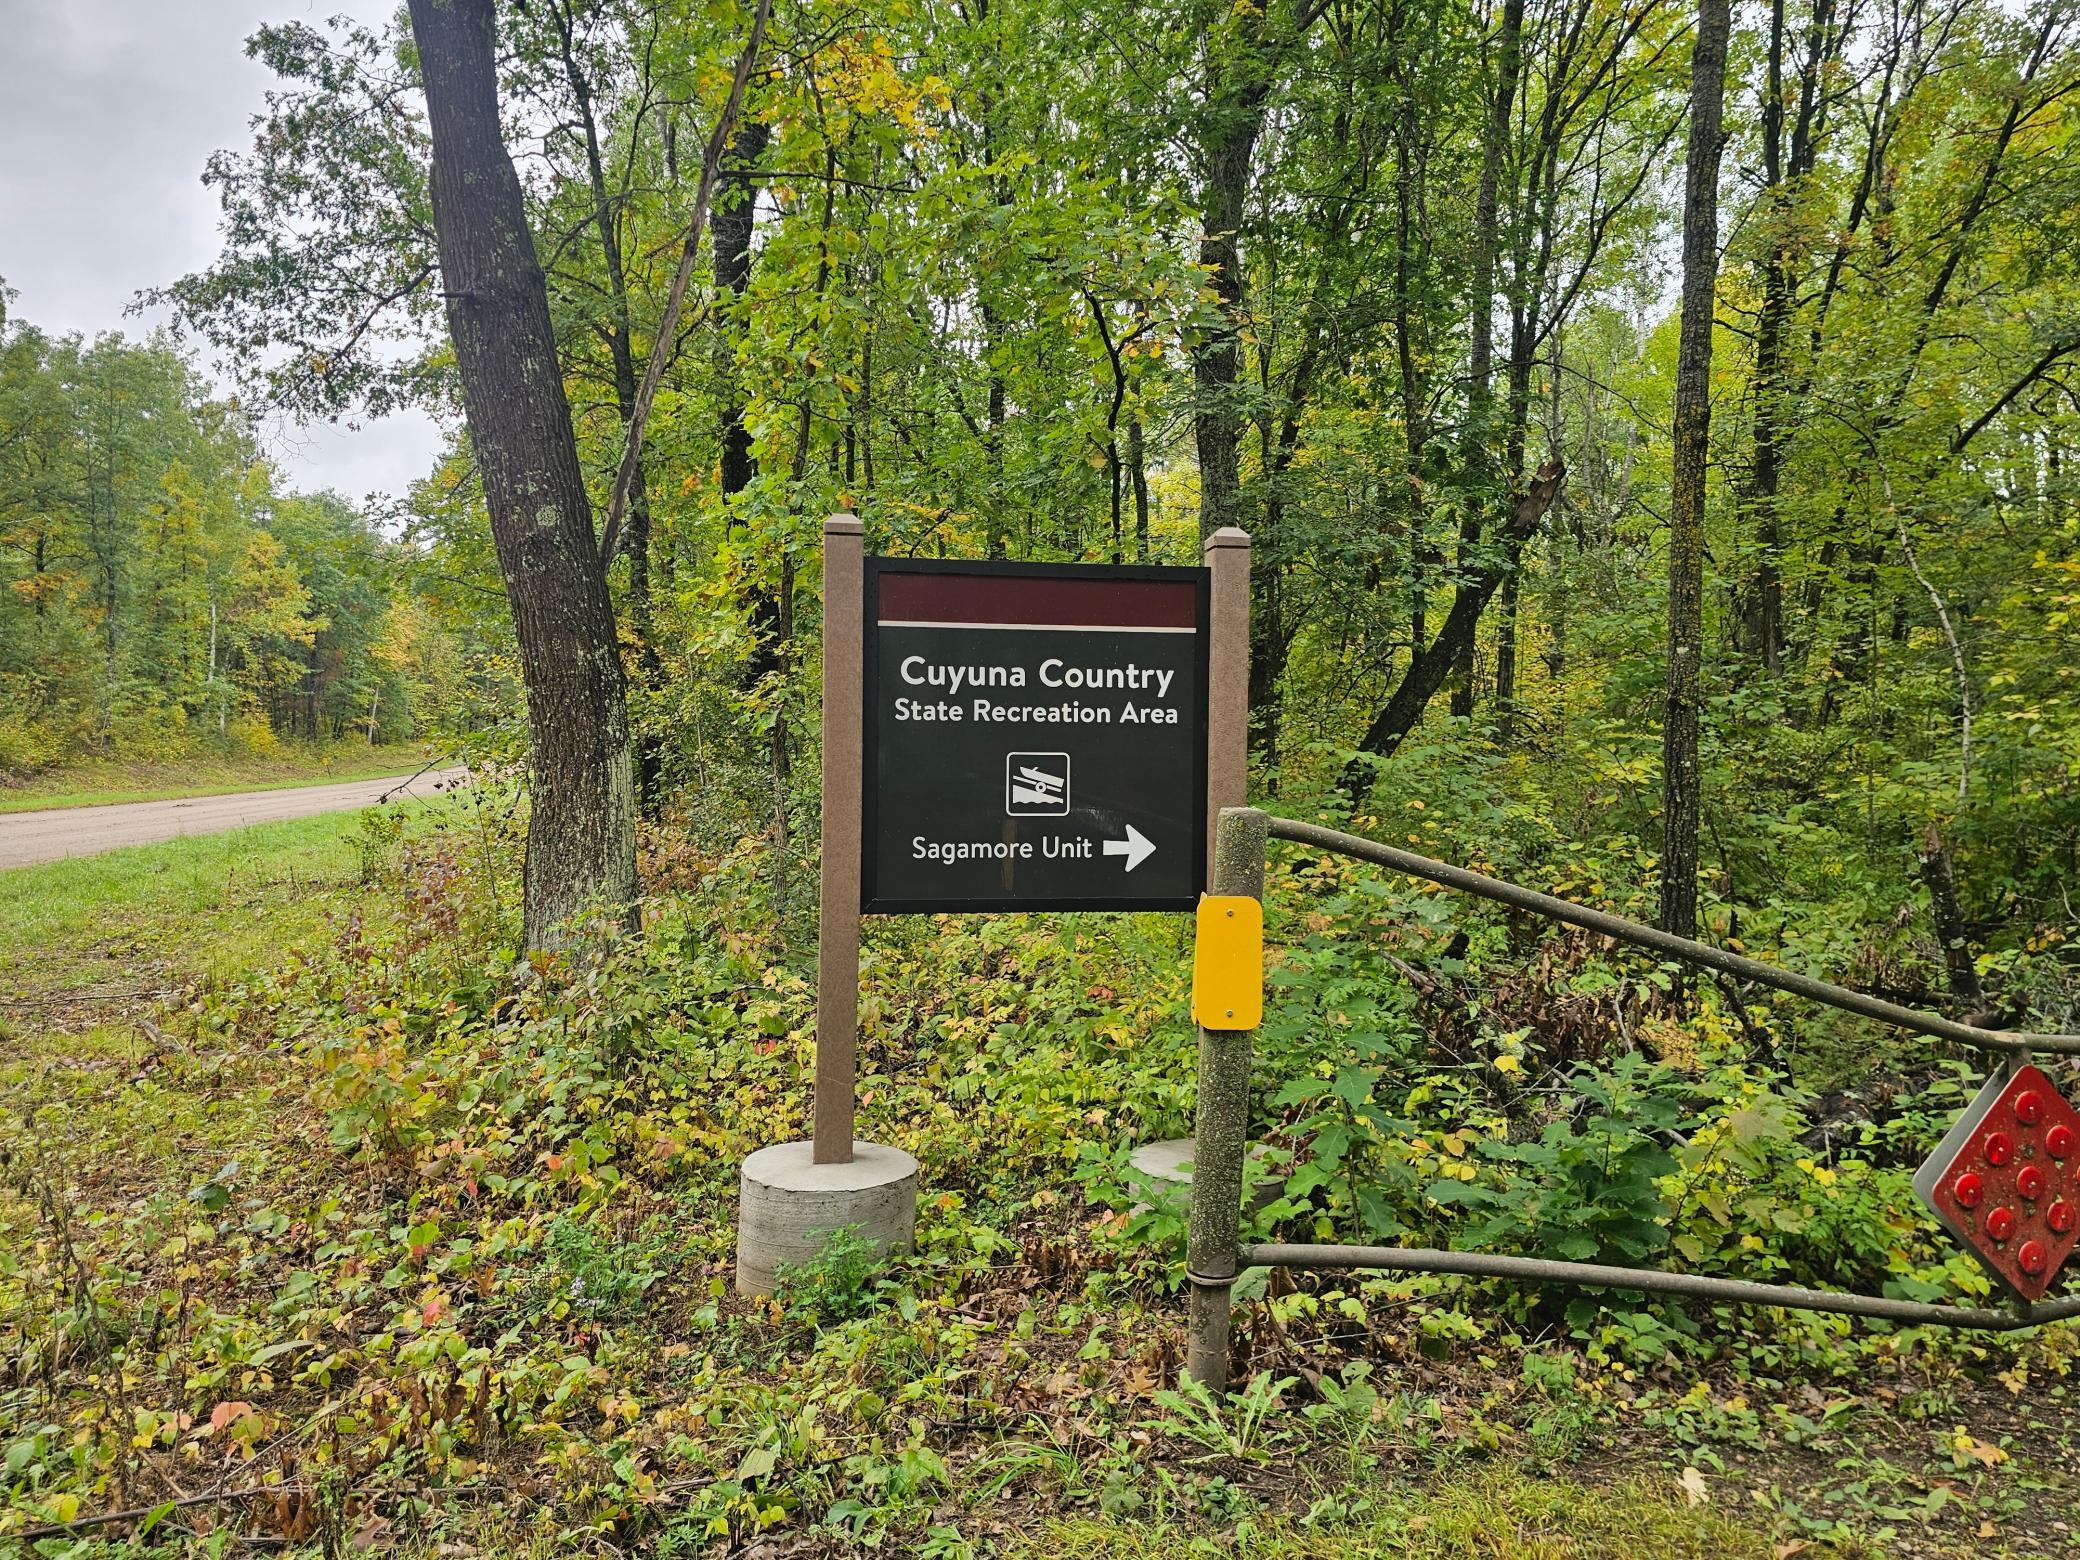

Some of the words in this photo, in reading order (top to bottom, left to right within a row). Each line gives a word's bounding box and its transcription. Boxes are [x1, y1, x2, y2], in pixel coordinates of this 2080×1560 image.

[901, 656, 1025, 694] Cuyuna
[1039, 659, 1174, 697] Country
[895, 698, 963, 721] State
[974, 700, 1110, 722] Recreation
[1120, 702, 1177, 723] Area
[913, 837, 1032, 864] Sagamore
[1043, 836, 1092, 858] Unit
